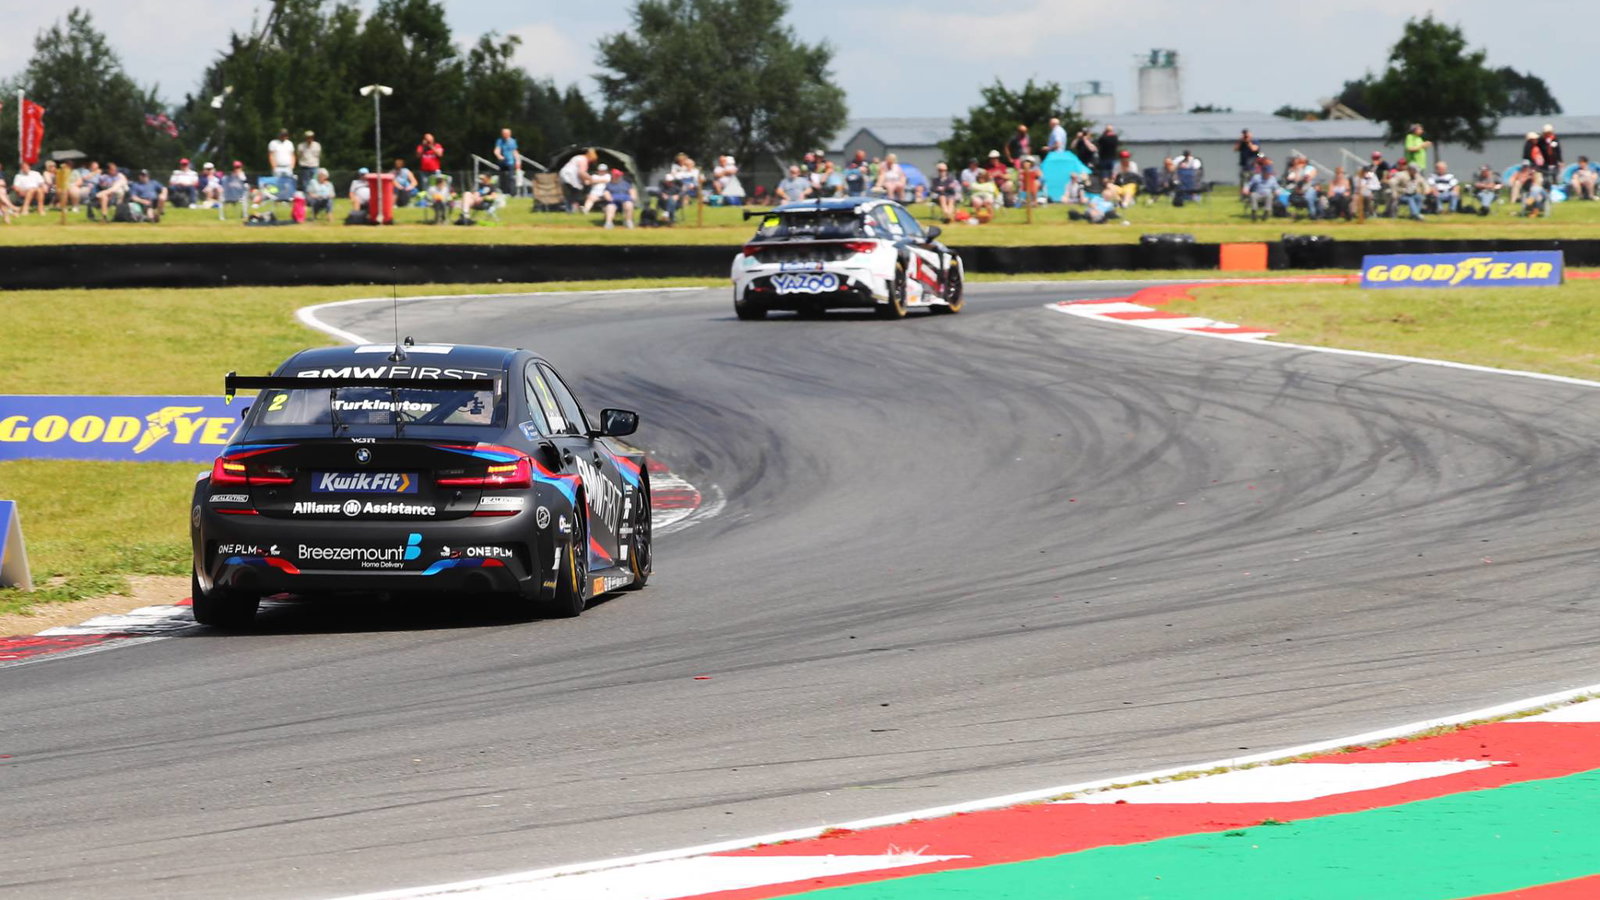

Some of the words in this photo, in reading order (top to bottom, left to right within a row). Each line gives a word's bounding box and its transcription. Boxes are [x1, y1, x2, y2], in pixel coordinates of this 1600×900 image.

[1366, 262, 1553, 282] GOODYEAR
[771, 273, 836, 292] YAZOO
[267, 394, 288, 411] 2
[333, 399, 432, 412] Turkington
[0, 415, 238, 444] GOODYE
[293, 502, 341, 514] Allianz
[363, 502, 436, 515] Assistance
[218, 544, 234, 554] ONE
[234, 544, 257, 555] PLM
[298, 544, 404, 560] Breezemount
[466, 546, 491, 557] ONE
[492, 546, 513, 558] PLM
[380, 561, 404, 569] Delivery
